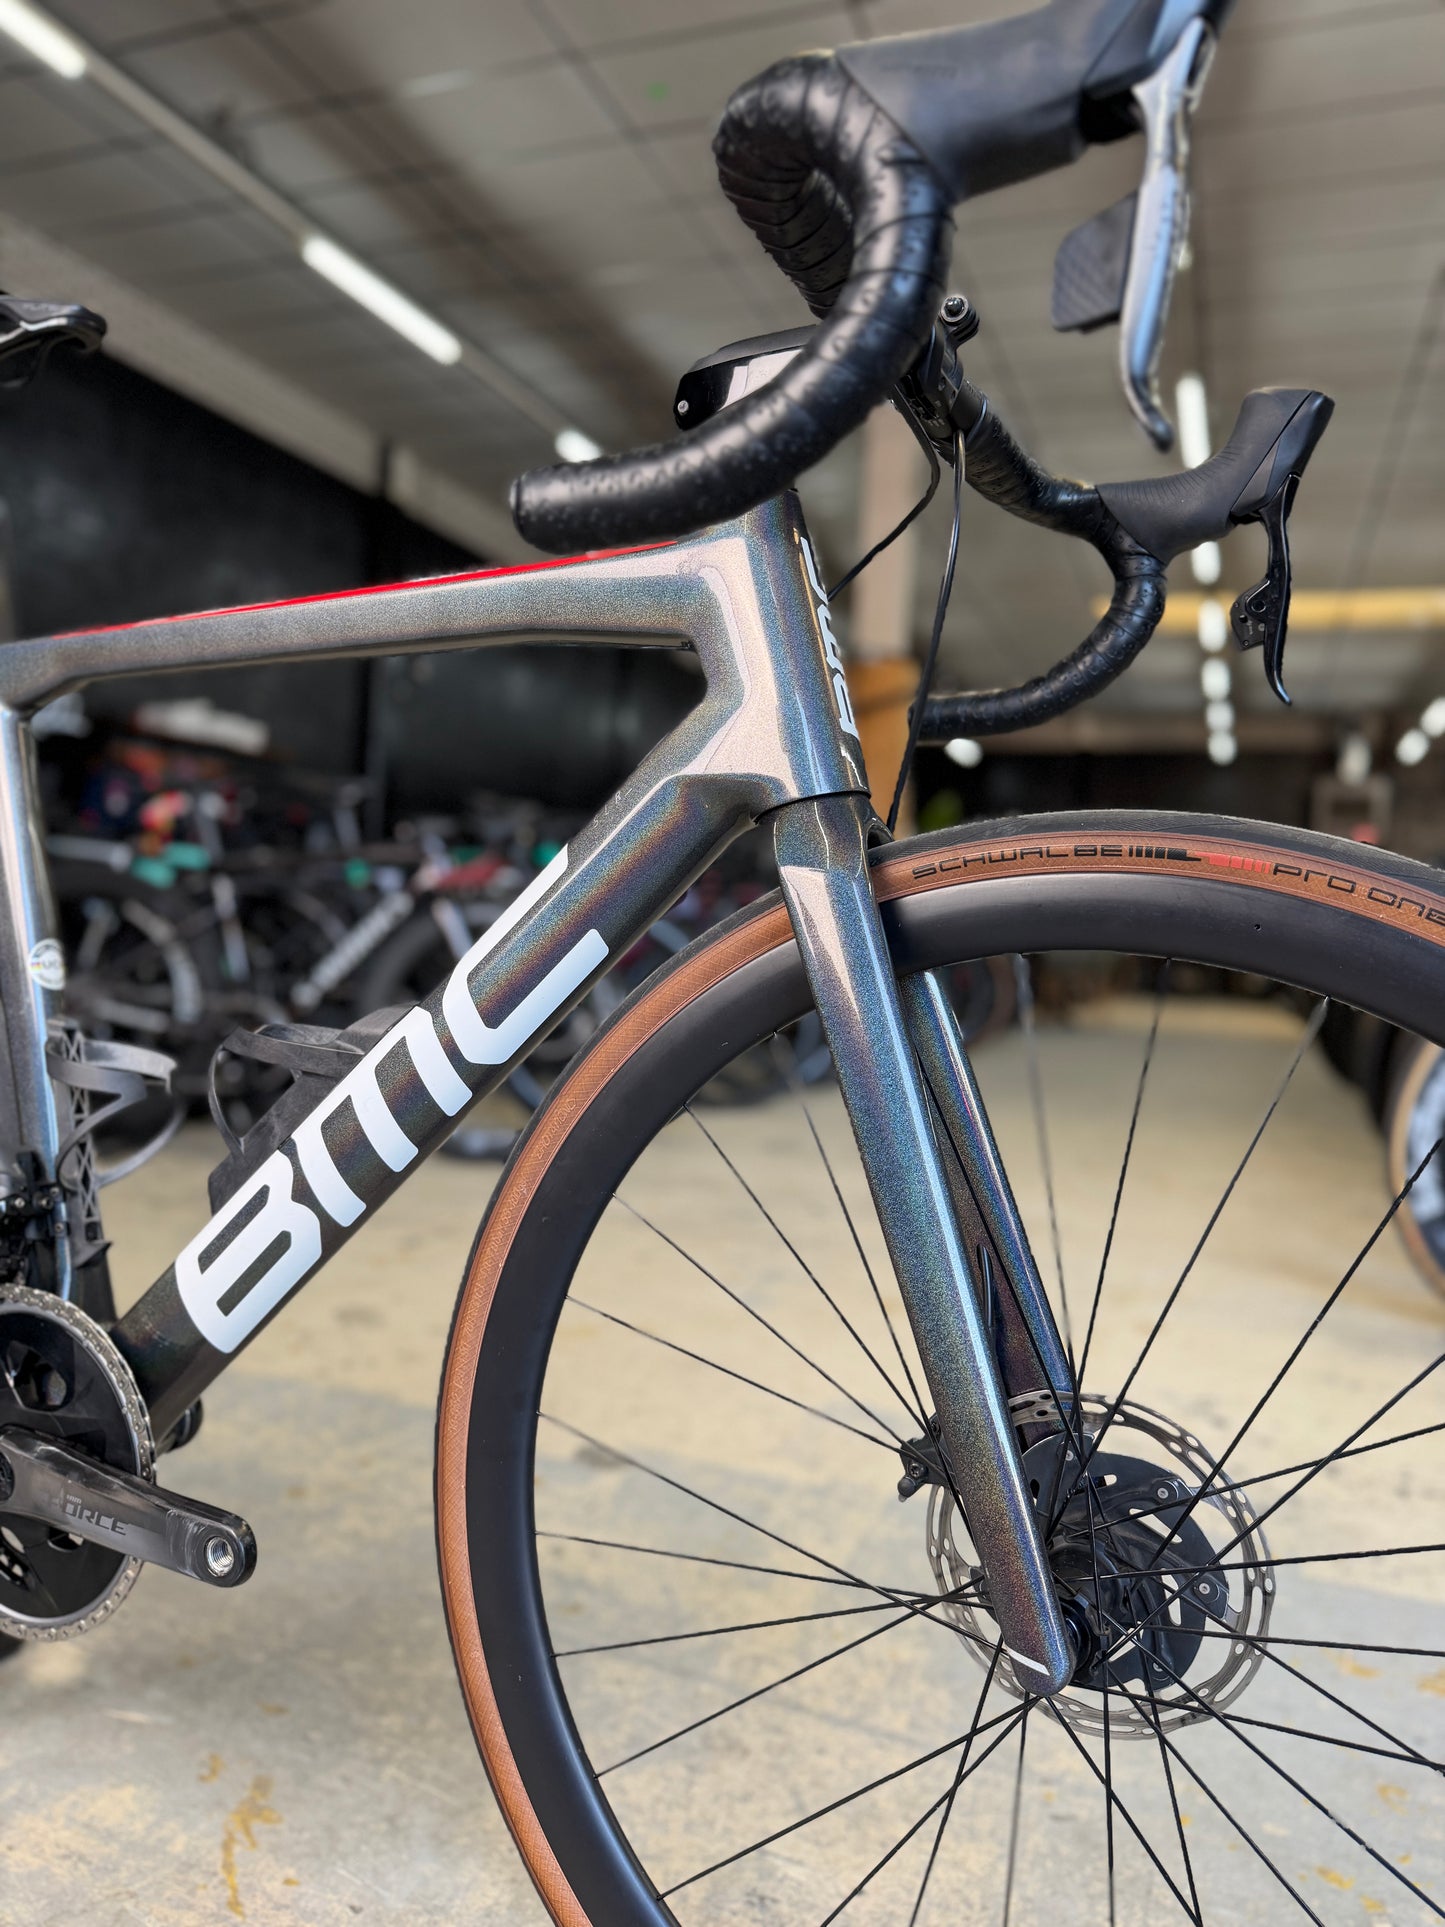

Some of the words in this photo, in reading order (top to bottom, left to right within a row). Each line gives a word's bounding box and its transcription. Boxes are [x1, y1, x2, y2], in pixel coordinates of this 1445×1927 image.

[912, 844, 1123, 880] SCHWALBE
[175, 843, 610, 1354] BMC
[48, 1491, 127, 1536] ORCE
